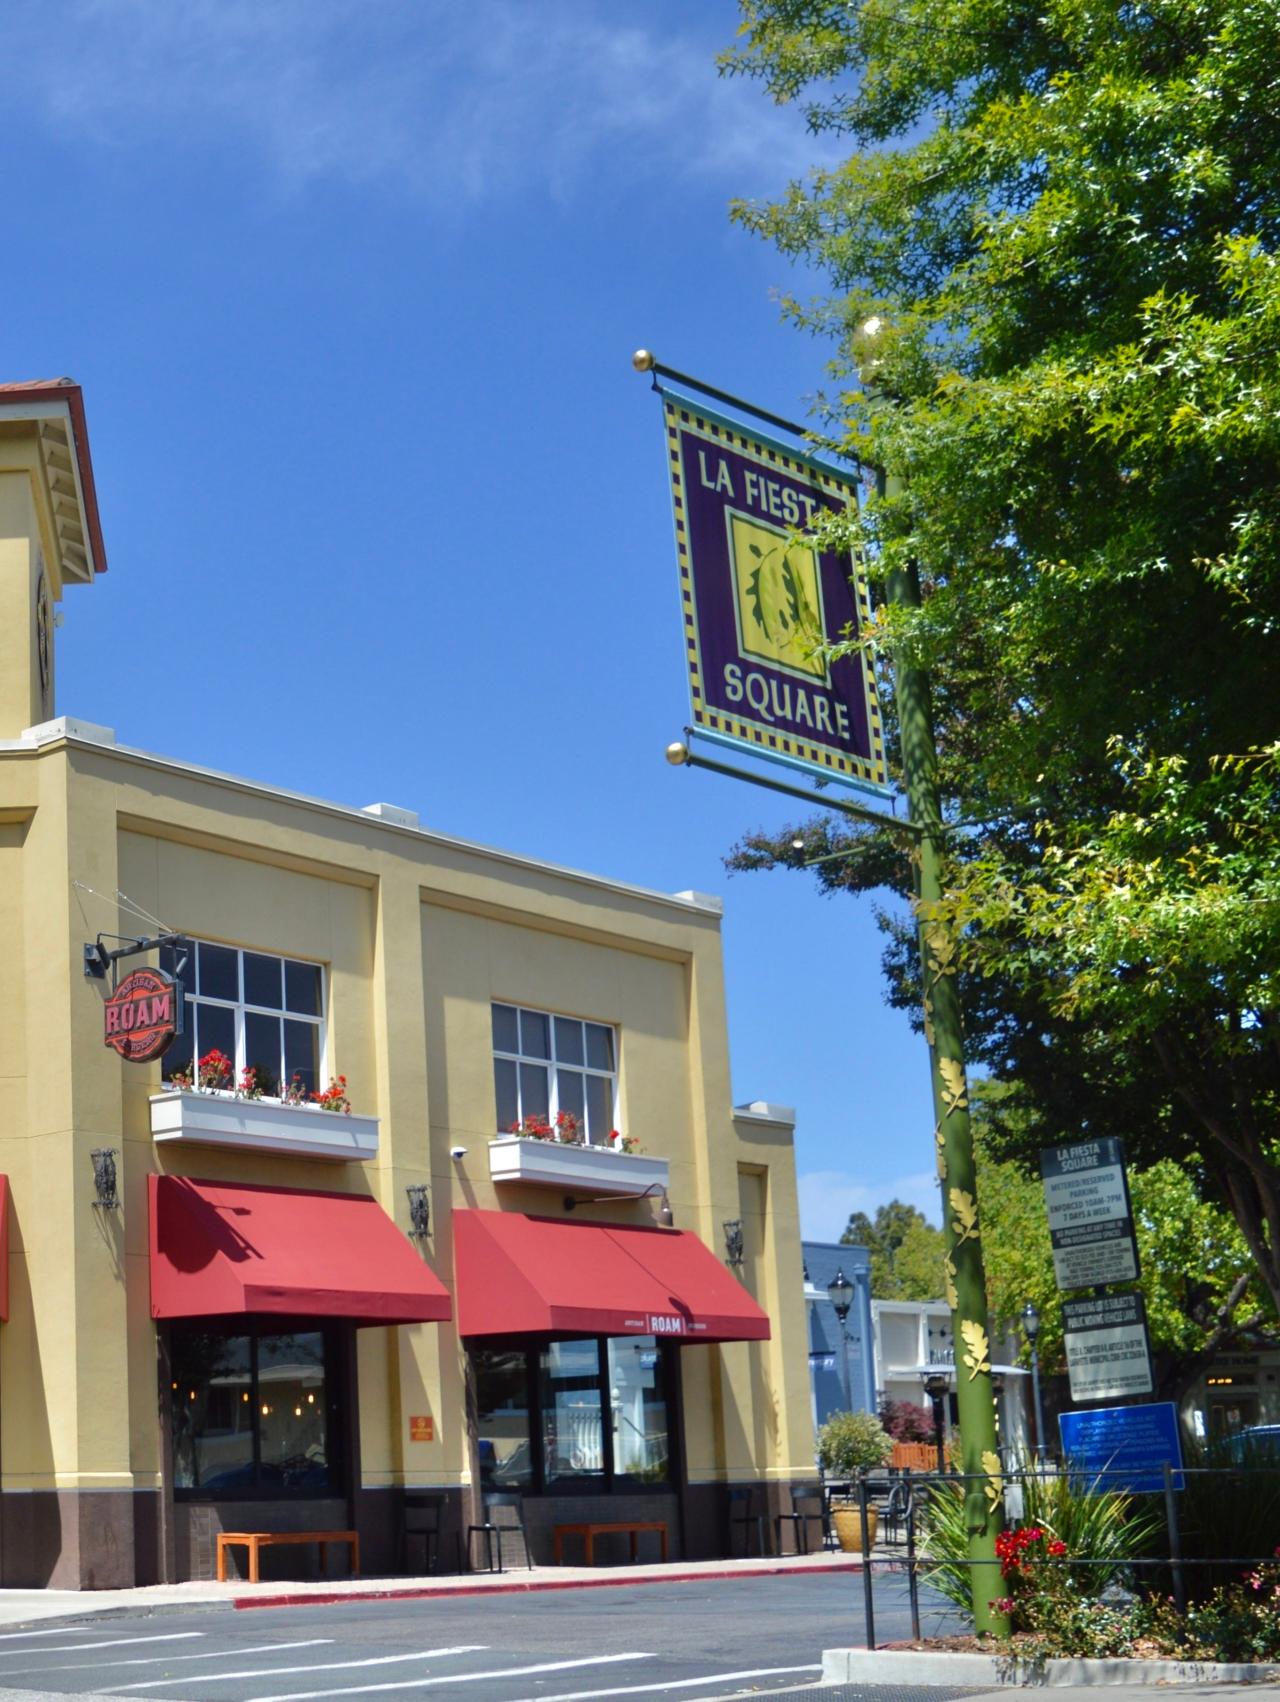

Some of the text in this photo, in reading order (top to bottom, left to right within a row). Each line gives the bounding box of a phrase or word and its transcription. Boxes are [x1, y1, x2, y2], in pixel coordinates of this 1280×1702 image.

[698, 449, 734, 498] LA
[724, 662, 850, 740] SQUARE
[106, 993, 171, 1034] ROAM
[1056, 1148, 1070, 1161] LA
[1070, 1143, 1100, 1159] FIESTA
[1061, 1155, 1099, 1172] SQUARE
[1069, 1186, 1099, 1198] PARKING
[651, 1316, 681, 1333] ROAM
